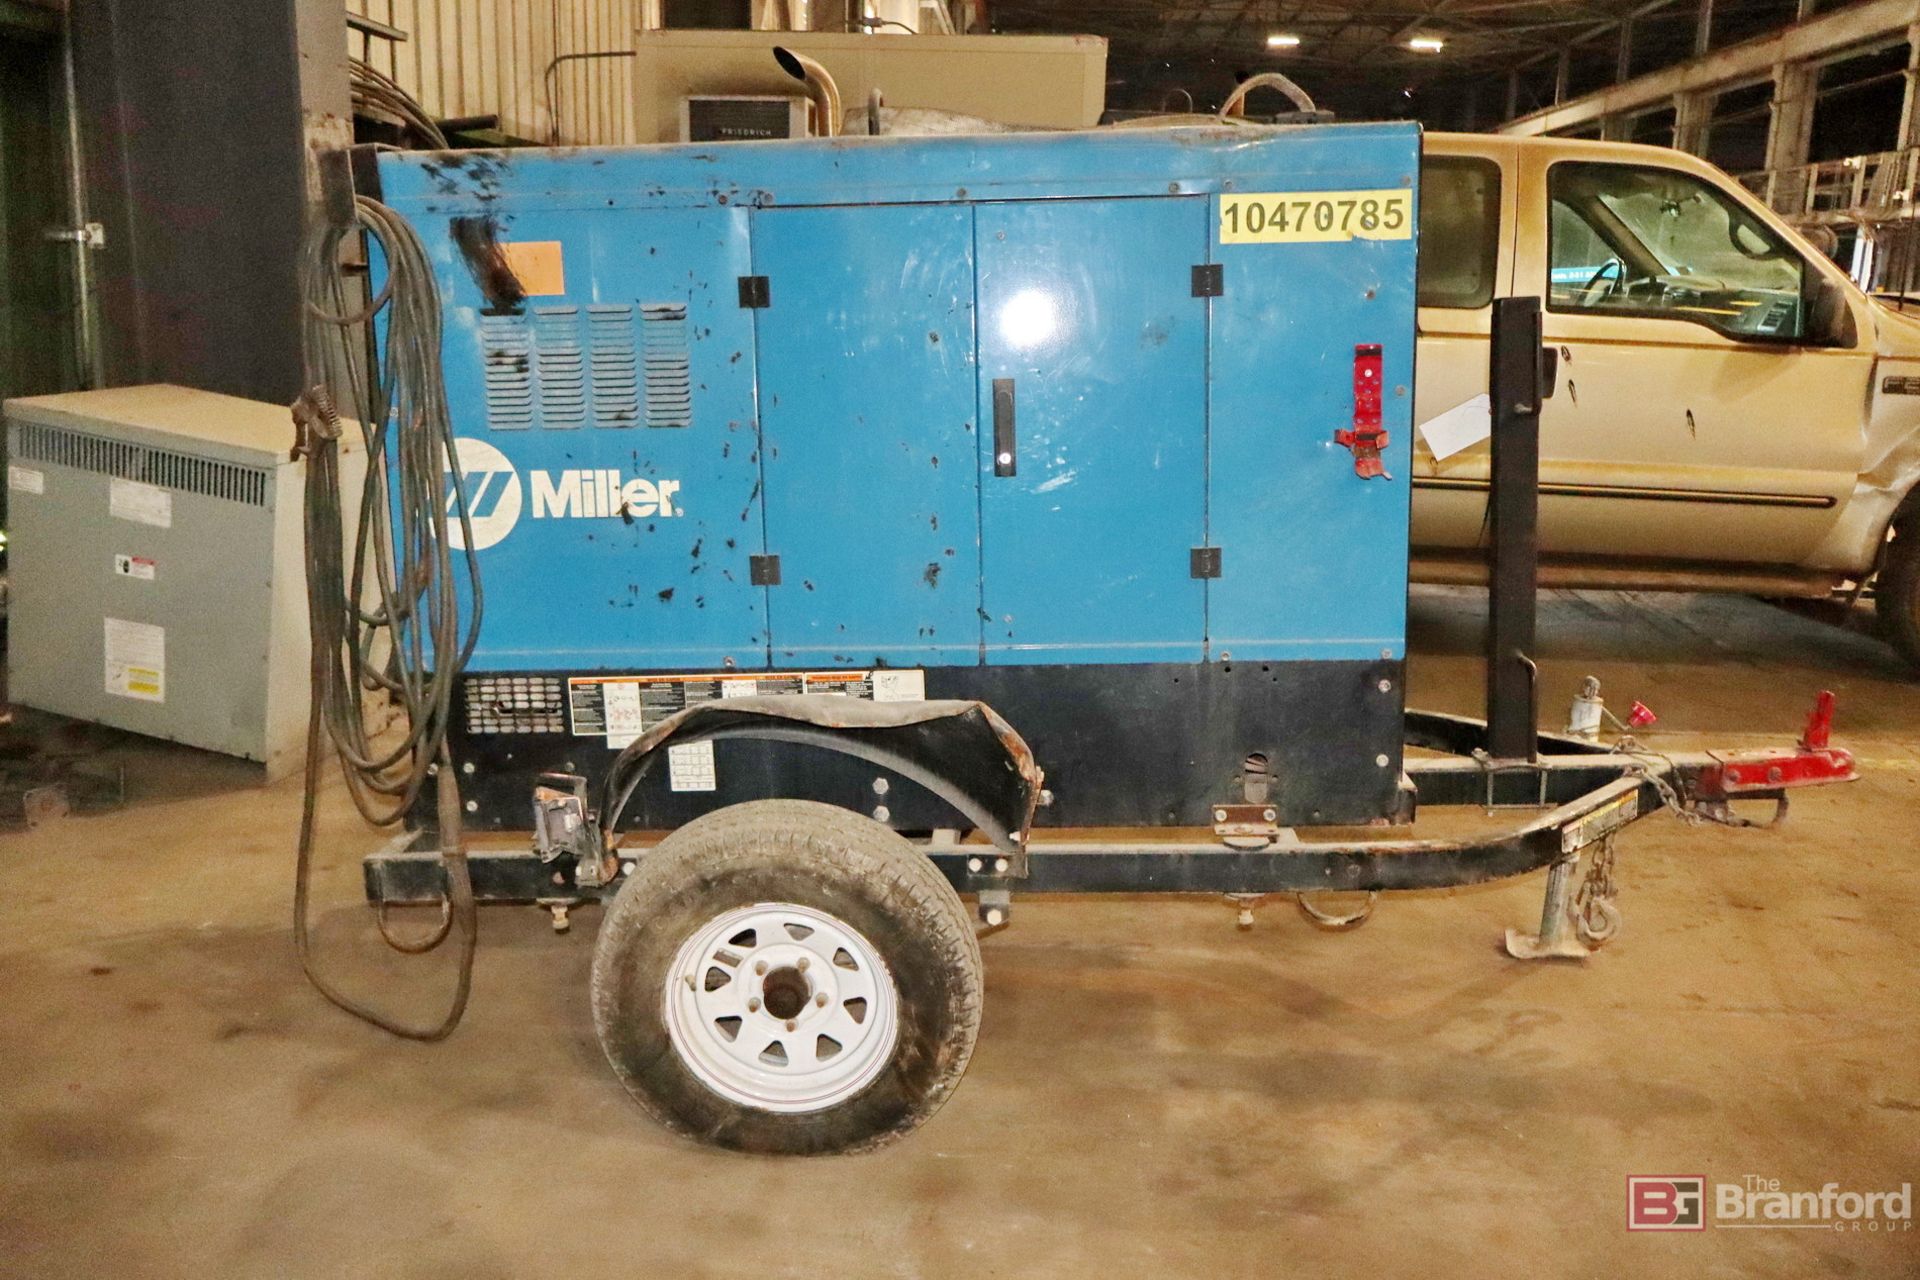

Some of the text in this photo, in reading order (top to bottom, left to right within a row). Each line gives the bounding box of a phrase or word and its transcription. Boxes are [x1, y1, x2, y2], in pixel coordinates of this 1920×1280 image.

[721, 128, 772, 136] FRIEDRICH
[1224, 199, 1404, 234] 10470785
[530, 469, 680, 518] Miller
